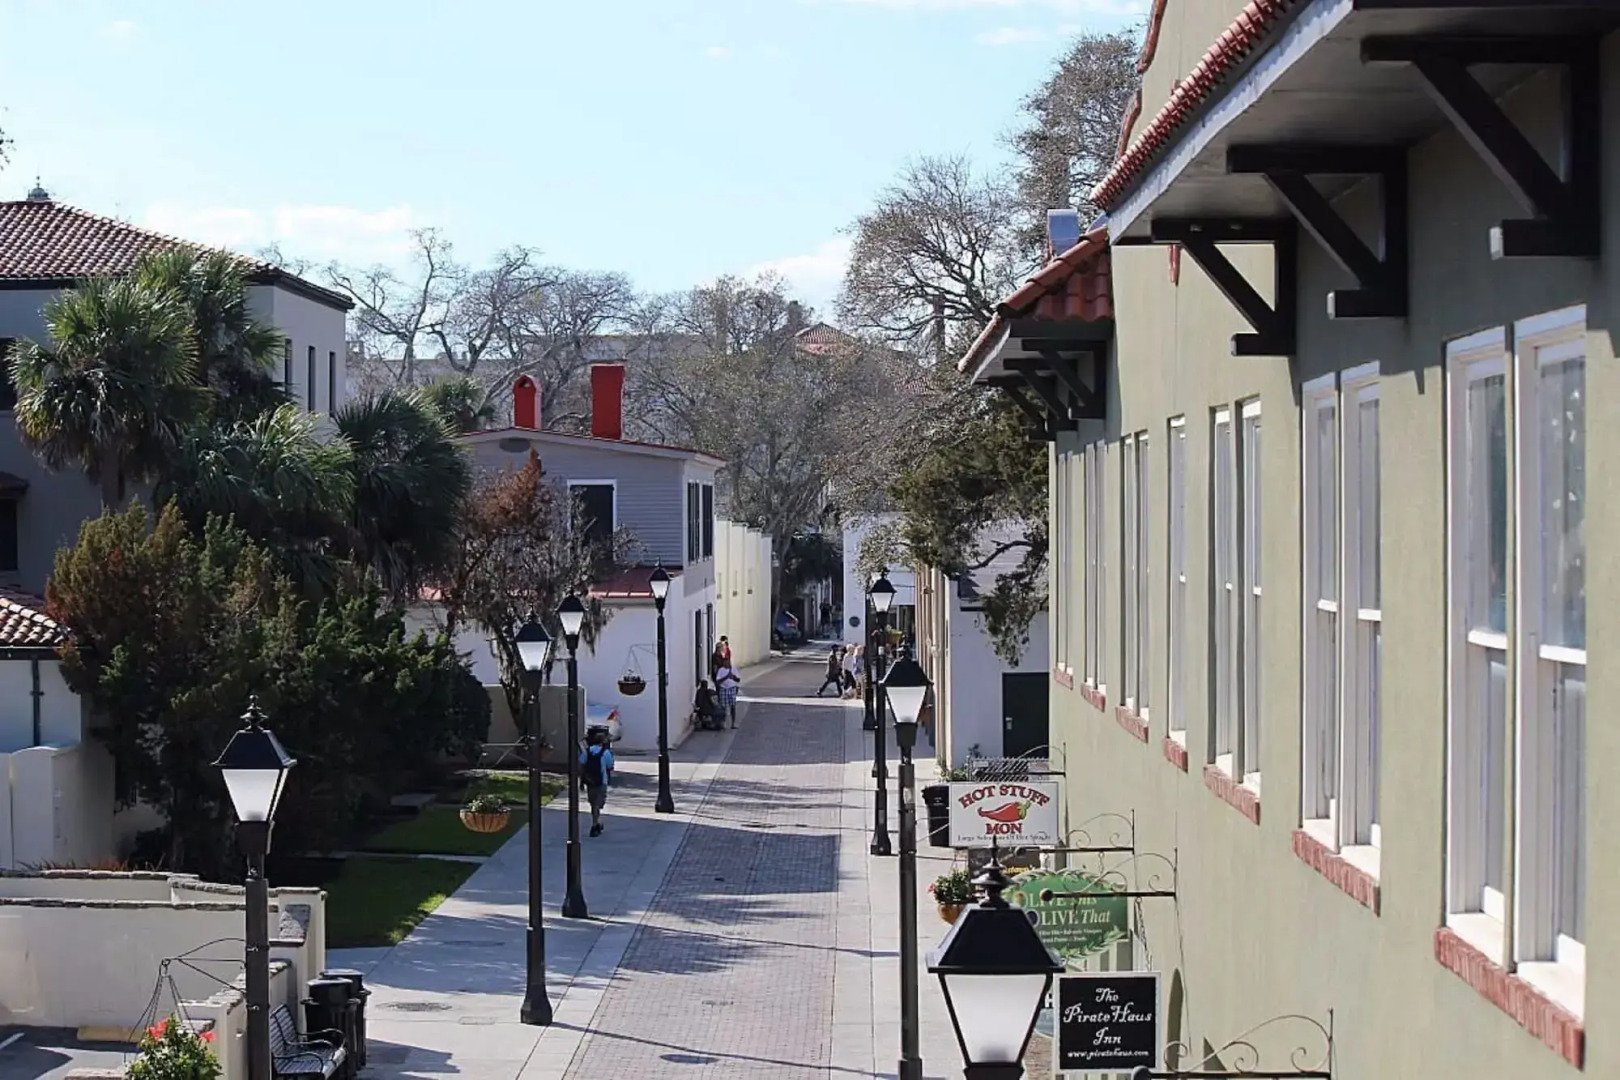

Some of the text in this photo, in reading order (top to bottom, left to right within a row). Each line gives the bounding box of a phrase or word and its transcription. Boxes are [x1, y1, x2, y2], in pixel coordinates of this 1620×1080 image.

[958, 785, 995, 809] HOT
[999, 784, 1050, 807] STUFF
[985, 823, 1023, 835] MON
[1081, 909, 1111, 925] That
[1095, 987, 1119, 1003] The
[1063, 1001, 1153, 1022] Pirate Haus
[1093, 1027, 1122, 1046] Inn
[1067, 1048, 1149, 1060] www.piratehaus.com
